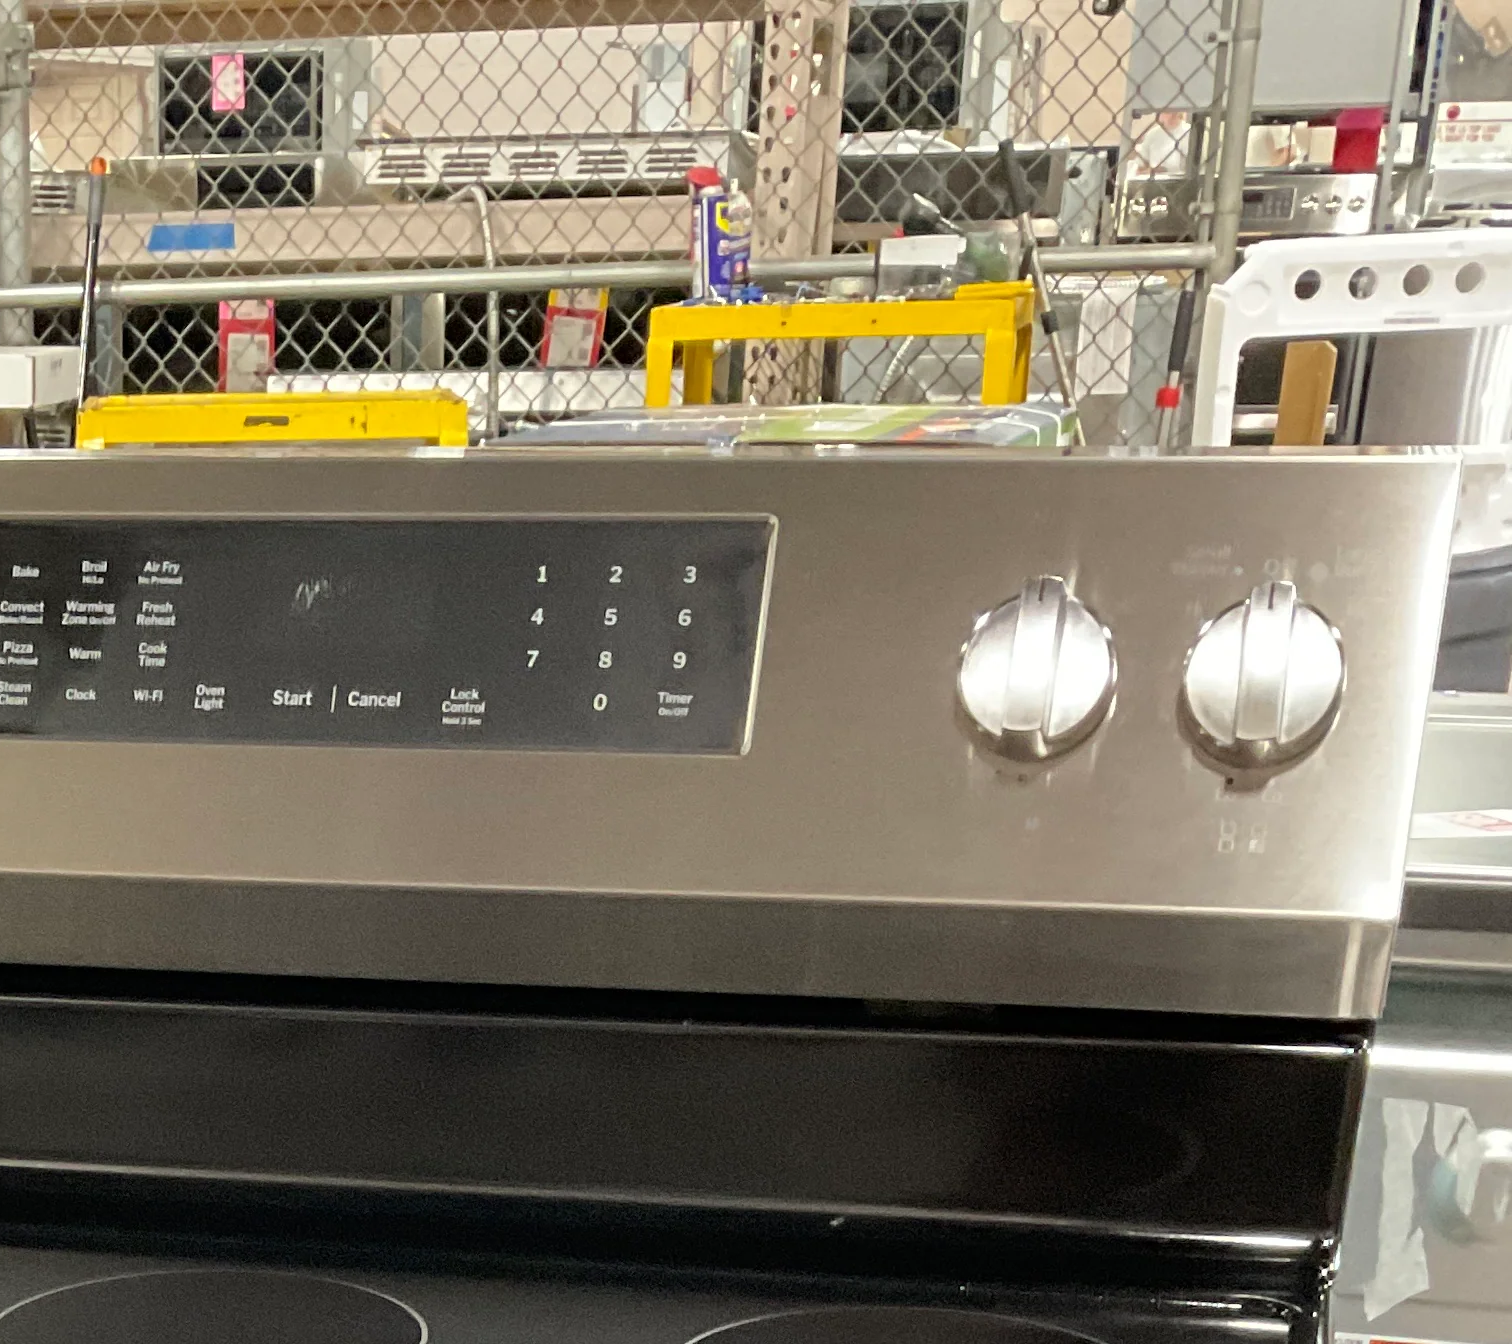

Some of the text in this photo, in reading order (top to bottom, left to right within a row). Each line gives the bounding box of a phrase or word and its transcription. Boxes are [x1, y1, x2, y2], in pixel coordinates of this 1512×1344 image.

[12, 565, 40, 578] Bake
[81, 560, 108, 573] Broil
[143, 560, 181, 575] Air Fry
[537, 565, 548, 583] 1
[609, 566, 623, 583] 2
[683, 566, 697, 584] 3
[0, 600, 45, 613] Convect
[65, 600, 116, 614] Warming
[141, 601, 173, 613] Fresh
[61, 613, 88, 625] Zone
[136, 613, 177, 626] Reheat
[530, 608, 544, 626] 4
[604, 608, 618, 626] 5
[678, 608, 692, 626] 6
[2, 640, 34, 654] Pizza
[69, 647, 102, 660] Warm
[138, 641, 168, 654] Cook
[138, 655, 166, 667] Time
[526, 649, 540, 668] 7
[598, 651, 613, 669] 8
[672, 651, 687, 669] 9
[65, 688, 96, 701] Clock
[196, 684, 225, 696] Oven
[450, 687, 480, 700] Lock
[194, 697, 225, 711] Light
[272, 689, 314, 706] Start
[347, 691, 401, 708] Cancel
[592, 692, 608, 711] 0
[657, 691, 694, 706] Timer
[441, 700, 486, 713] Control
[658, 706, 689, 717] On/Off
